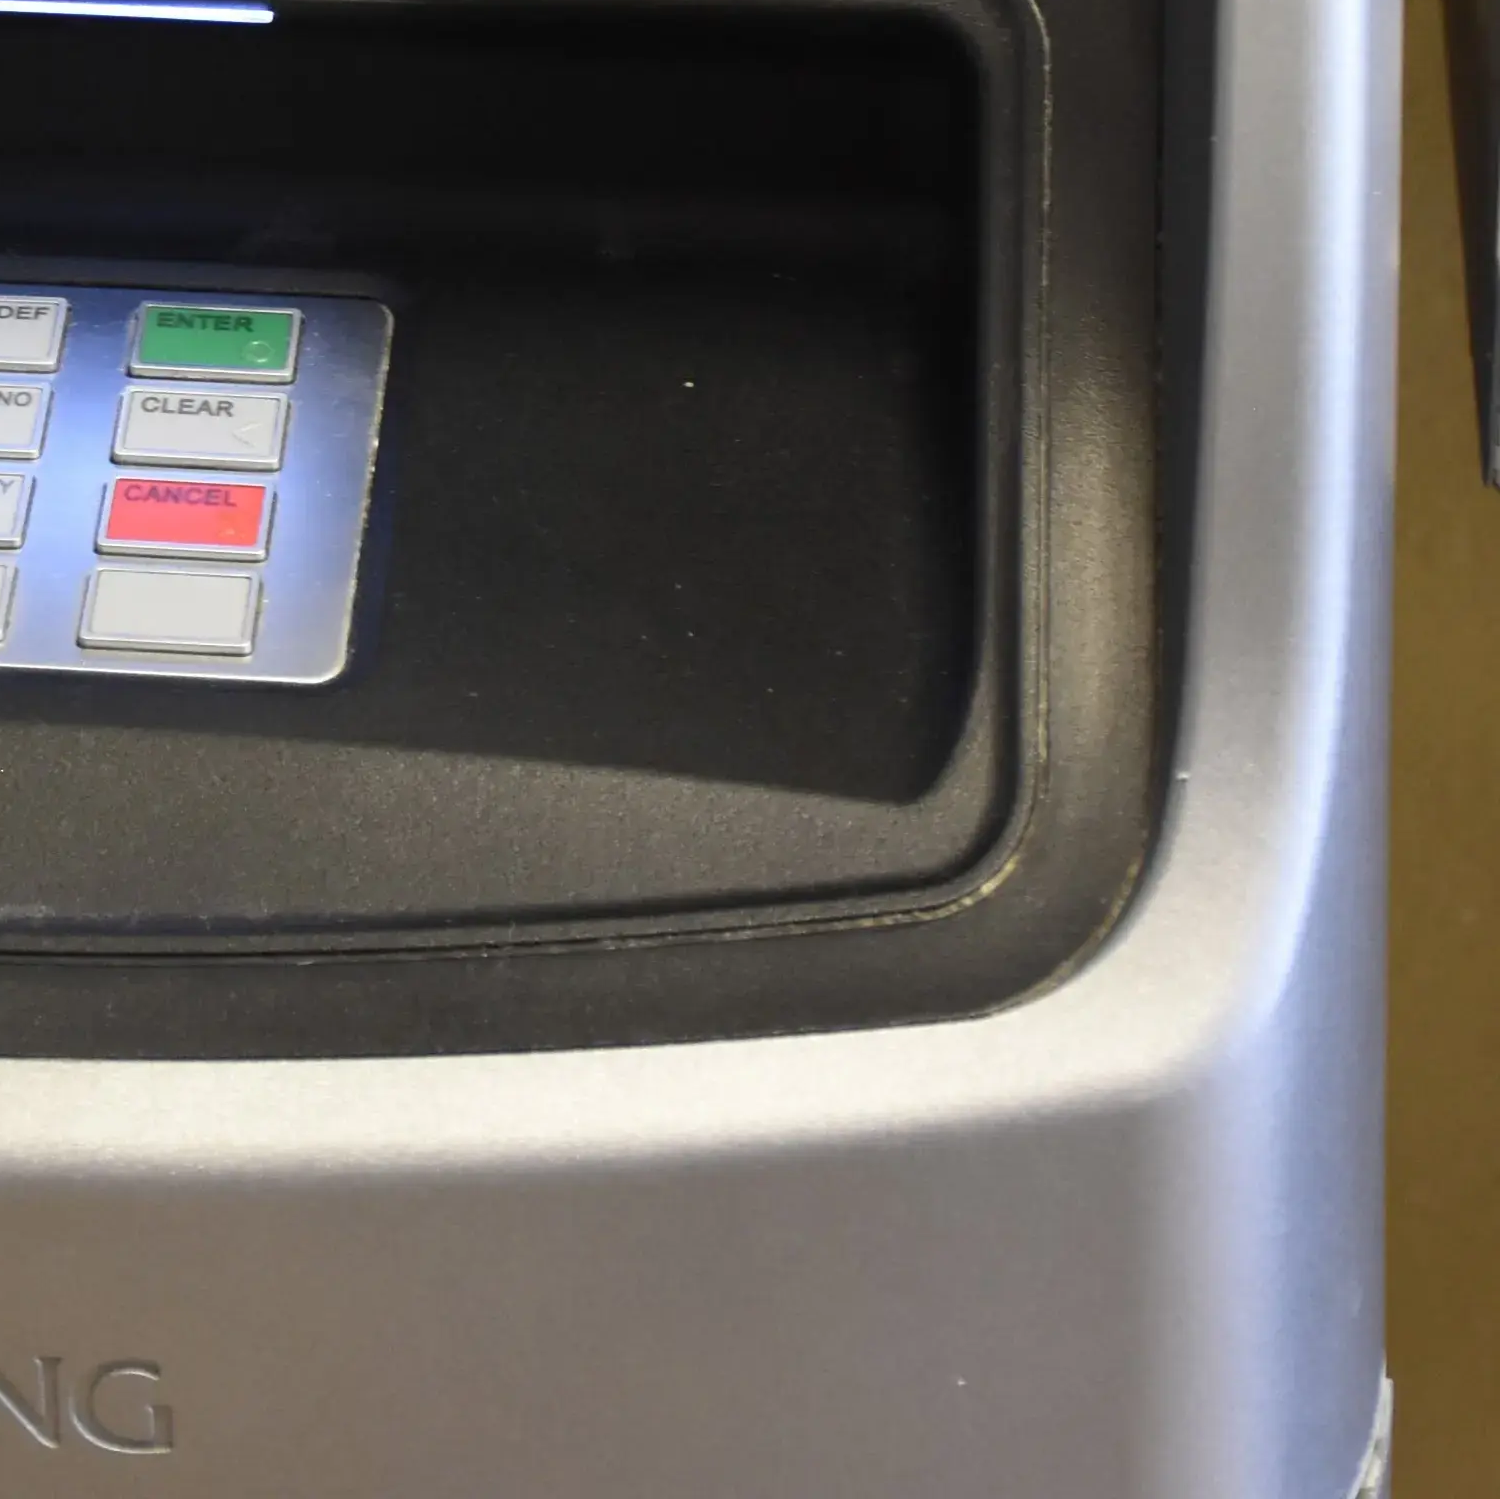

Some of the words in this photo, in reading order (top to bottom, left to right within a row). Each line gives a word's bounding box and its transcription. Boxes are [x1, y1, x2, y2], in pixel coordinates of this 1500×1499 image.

[156, 312, 254, 332] ENTER
[141, 396, 234, 417] CLEAR
[124, 485, 238, 507] CANCEL
